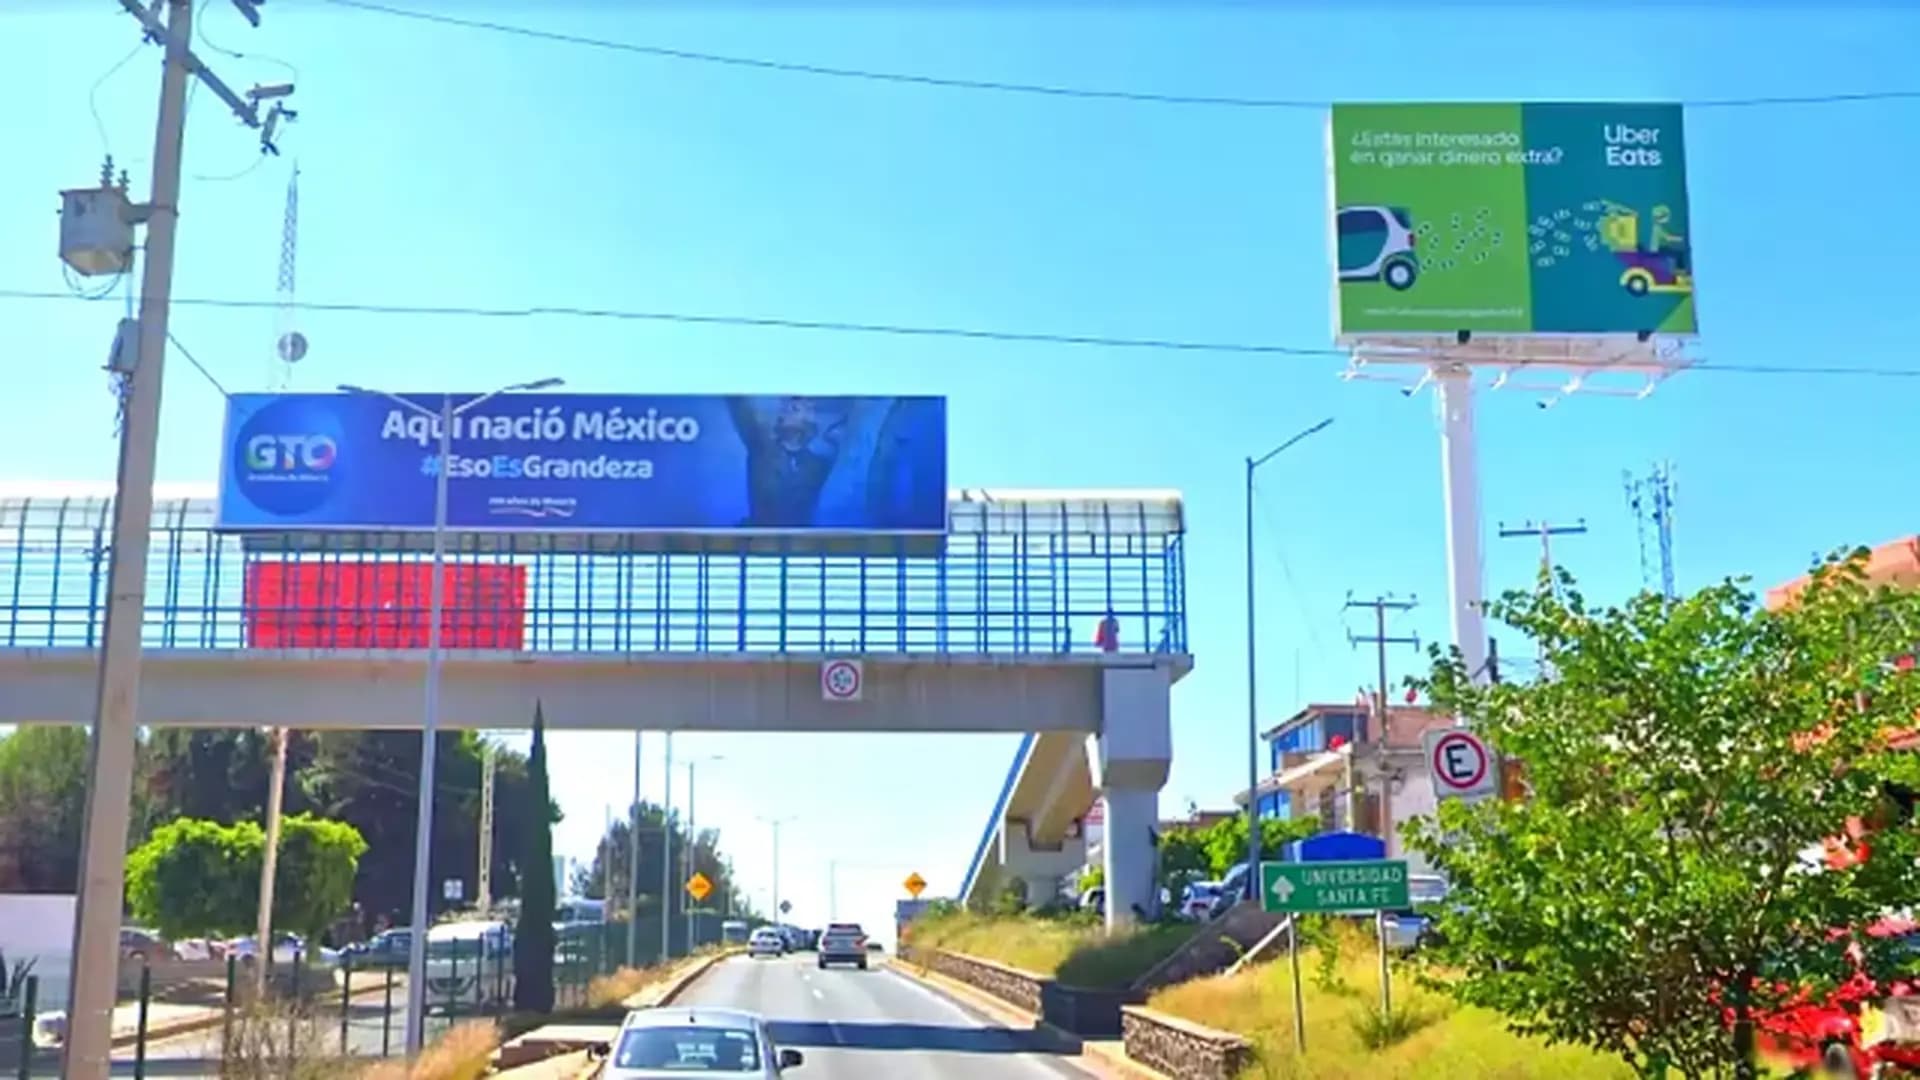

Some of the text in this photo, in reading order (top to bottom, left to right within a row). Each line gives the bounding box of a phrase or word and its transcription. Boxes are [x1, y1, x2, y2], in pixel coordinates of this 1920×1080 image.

[1604, 125, 1660, 144] Uber
[1350, 146, 1564, 168] en ganar dinero extra?
[1605, 146, 1662, 166] Eats
[469, 405, 566, 441] nació
[572, 406, 700, 441] México
[246, 434, 337, 471] GTO
[421, 455, 653, 479] #EsoEsGrandeza
[1446, 744, 1473, 778] E
[1301, 866, 1403, 886] UNIVERSIDAD
[1316, 887, 1368, 904] SANTA
